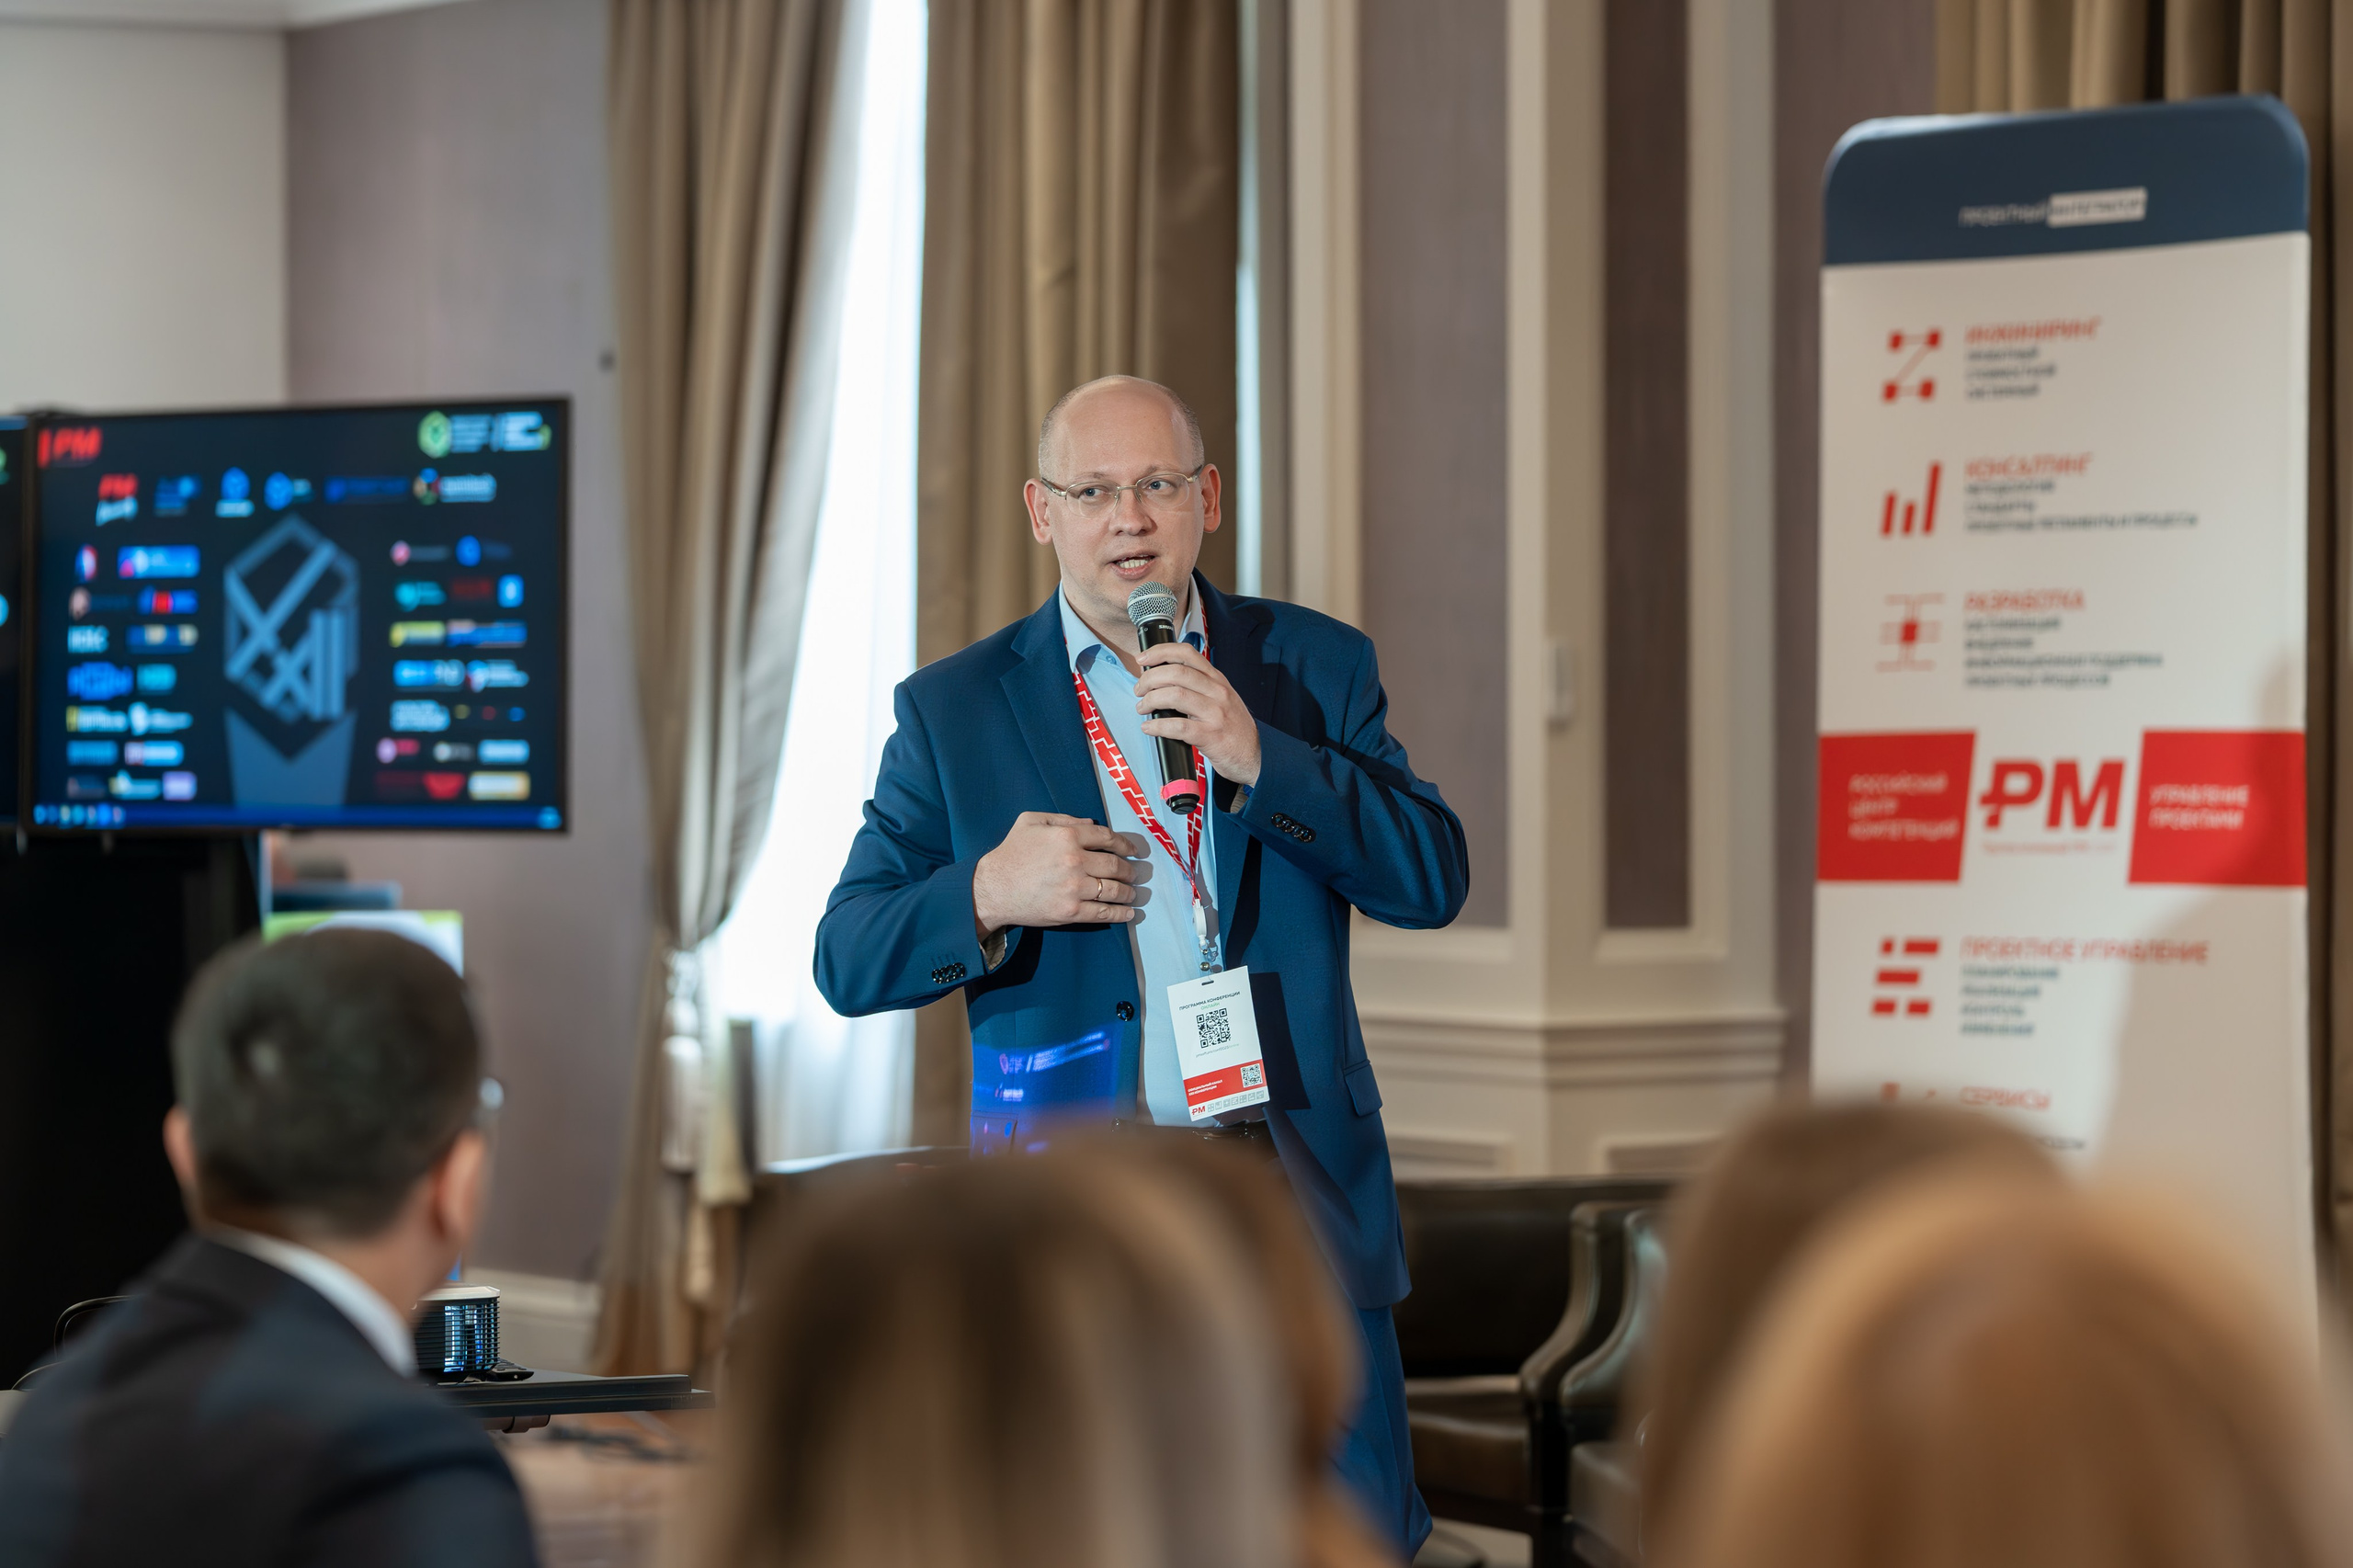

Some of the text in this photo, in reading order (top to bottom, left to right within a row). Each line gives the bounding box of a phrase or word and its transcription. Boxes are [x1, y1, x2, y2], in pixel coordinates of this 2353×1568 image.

[1964, 589, 2086, 612] РАЗРАБОТКА
[2149, 783, 2250, 809] УПРАВЛЕНИЕ
[2148, 807, 2245, 831] ПРОЕКТАМИ
[1961, 937, 2210, 966] ПРОЕКТНОЕ УПРАВЛЕНИЕ
[1178, 991, 1241, 1011] ПРОГРАММА КОНФЕРЕНЦИИ
[1960, 1086, 2051, 1112] СЕРВИСЫ
